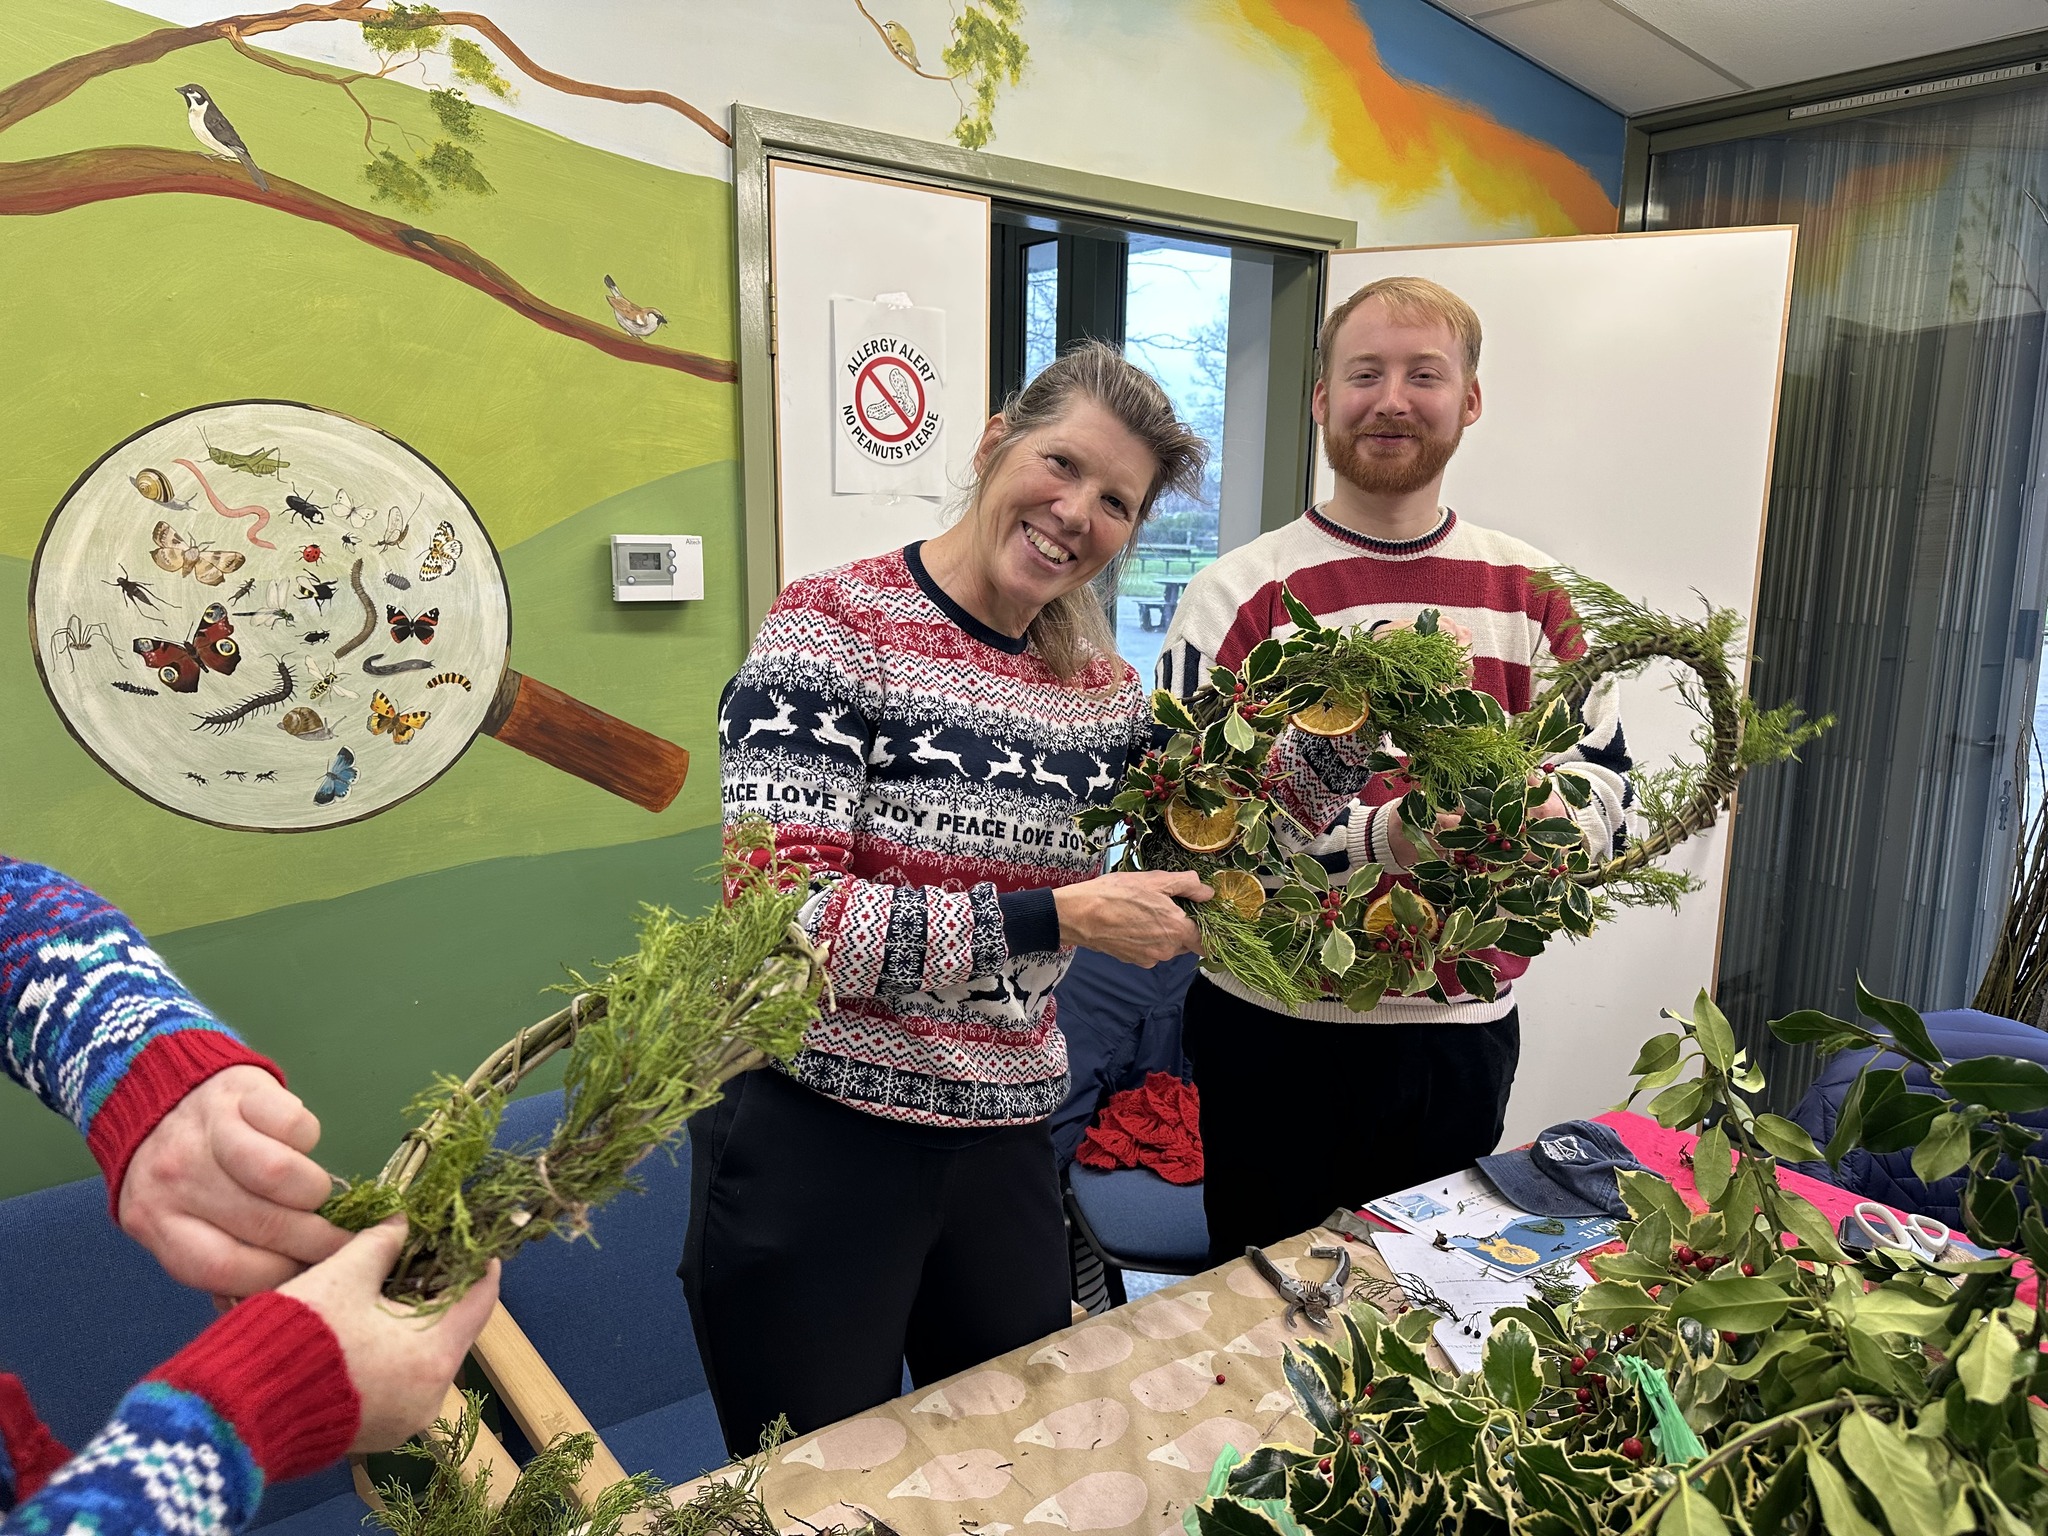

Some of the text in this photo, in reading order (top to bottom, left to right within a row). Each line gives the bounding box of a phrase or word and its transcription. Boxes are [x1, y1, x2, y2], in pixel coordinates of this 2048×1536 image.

[847, 338, 935, 382] ALLERGY ALERT
[843, 405, 939, 459] NO PEANUTS PLEASE
[723, 783, 758, 804] EACE
[767, 783, 837, 811] LOVE
[874, 800, 929, 828] JOY
[936, 812, 1007, 839] PEACE
[1012, 824, 1054, 847] LOVE
